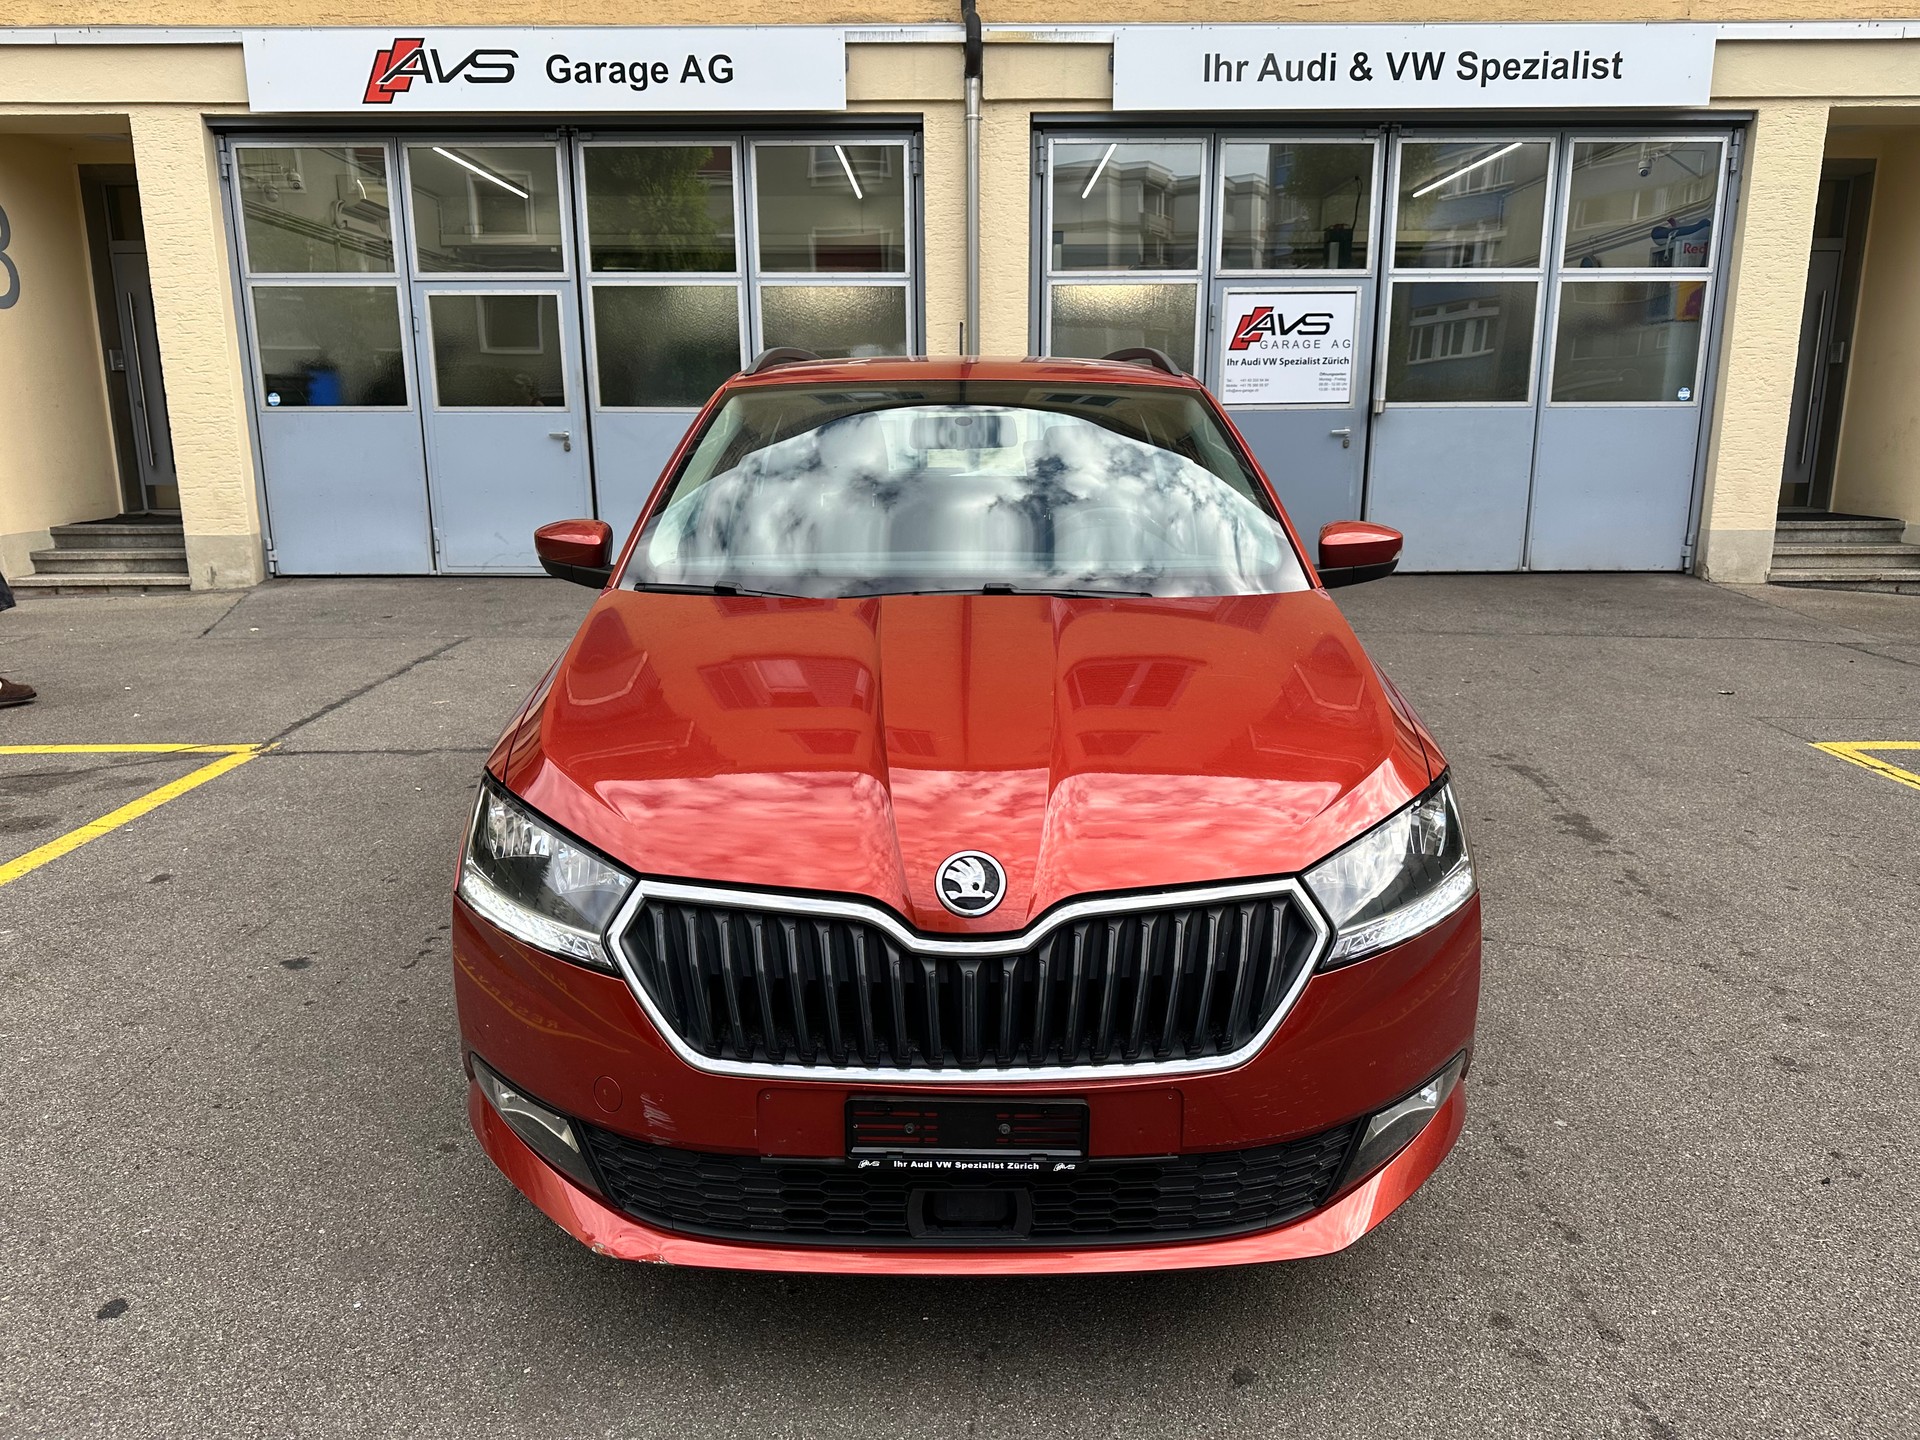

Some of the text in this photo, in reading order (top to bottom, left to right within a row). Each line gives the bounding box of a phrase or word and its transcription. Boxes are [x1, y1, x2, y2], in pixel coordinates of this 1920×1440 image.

[378, 48, 735, 92] AVS Garage AG
[1202, 49, 1624, 88] Ihr Audi & VW Spezialist
[1241, 312, 1334, 336] AVS
[1259, 338, 1351, 350] GARAGE AG
[1226, 356, 1350, 367] Ihr Audi VW Spezialist Zürich
[893, 1160, 908, 1168] Ihr
[910, 1160, 933, 1168] Audi
[935, 1161, 952, 1169] VW
[954, 1161, 1005, 1170] Spezialist
[1006, 1162, 1040, 1170] Zürich
